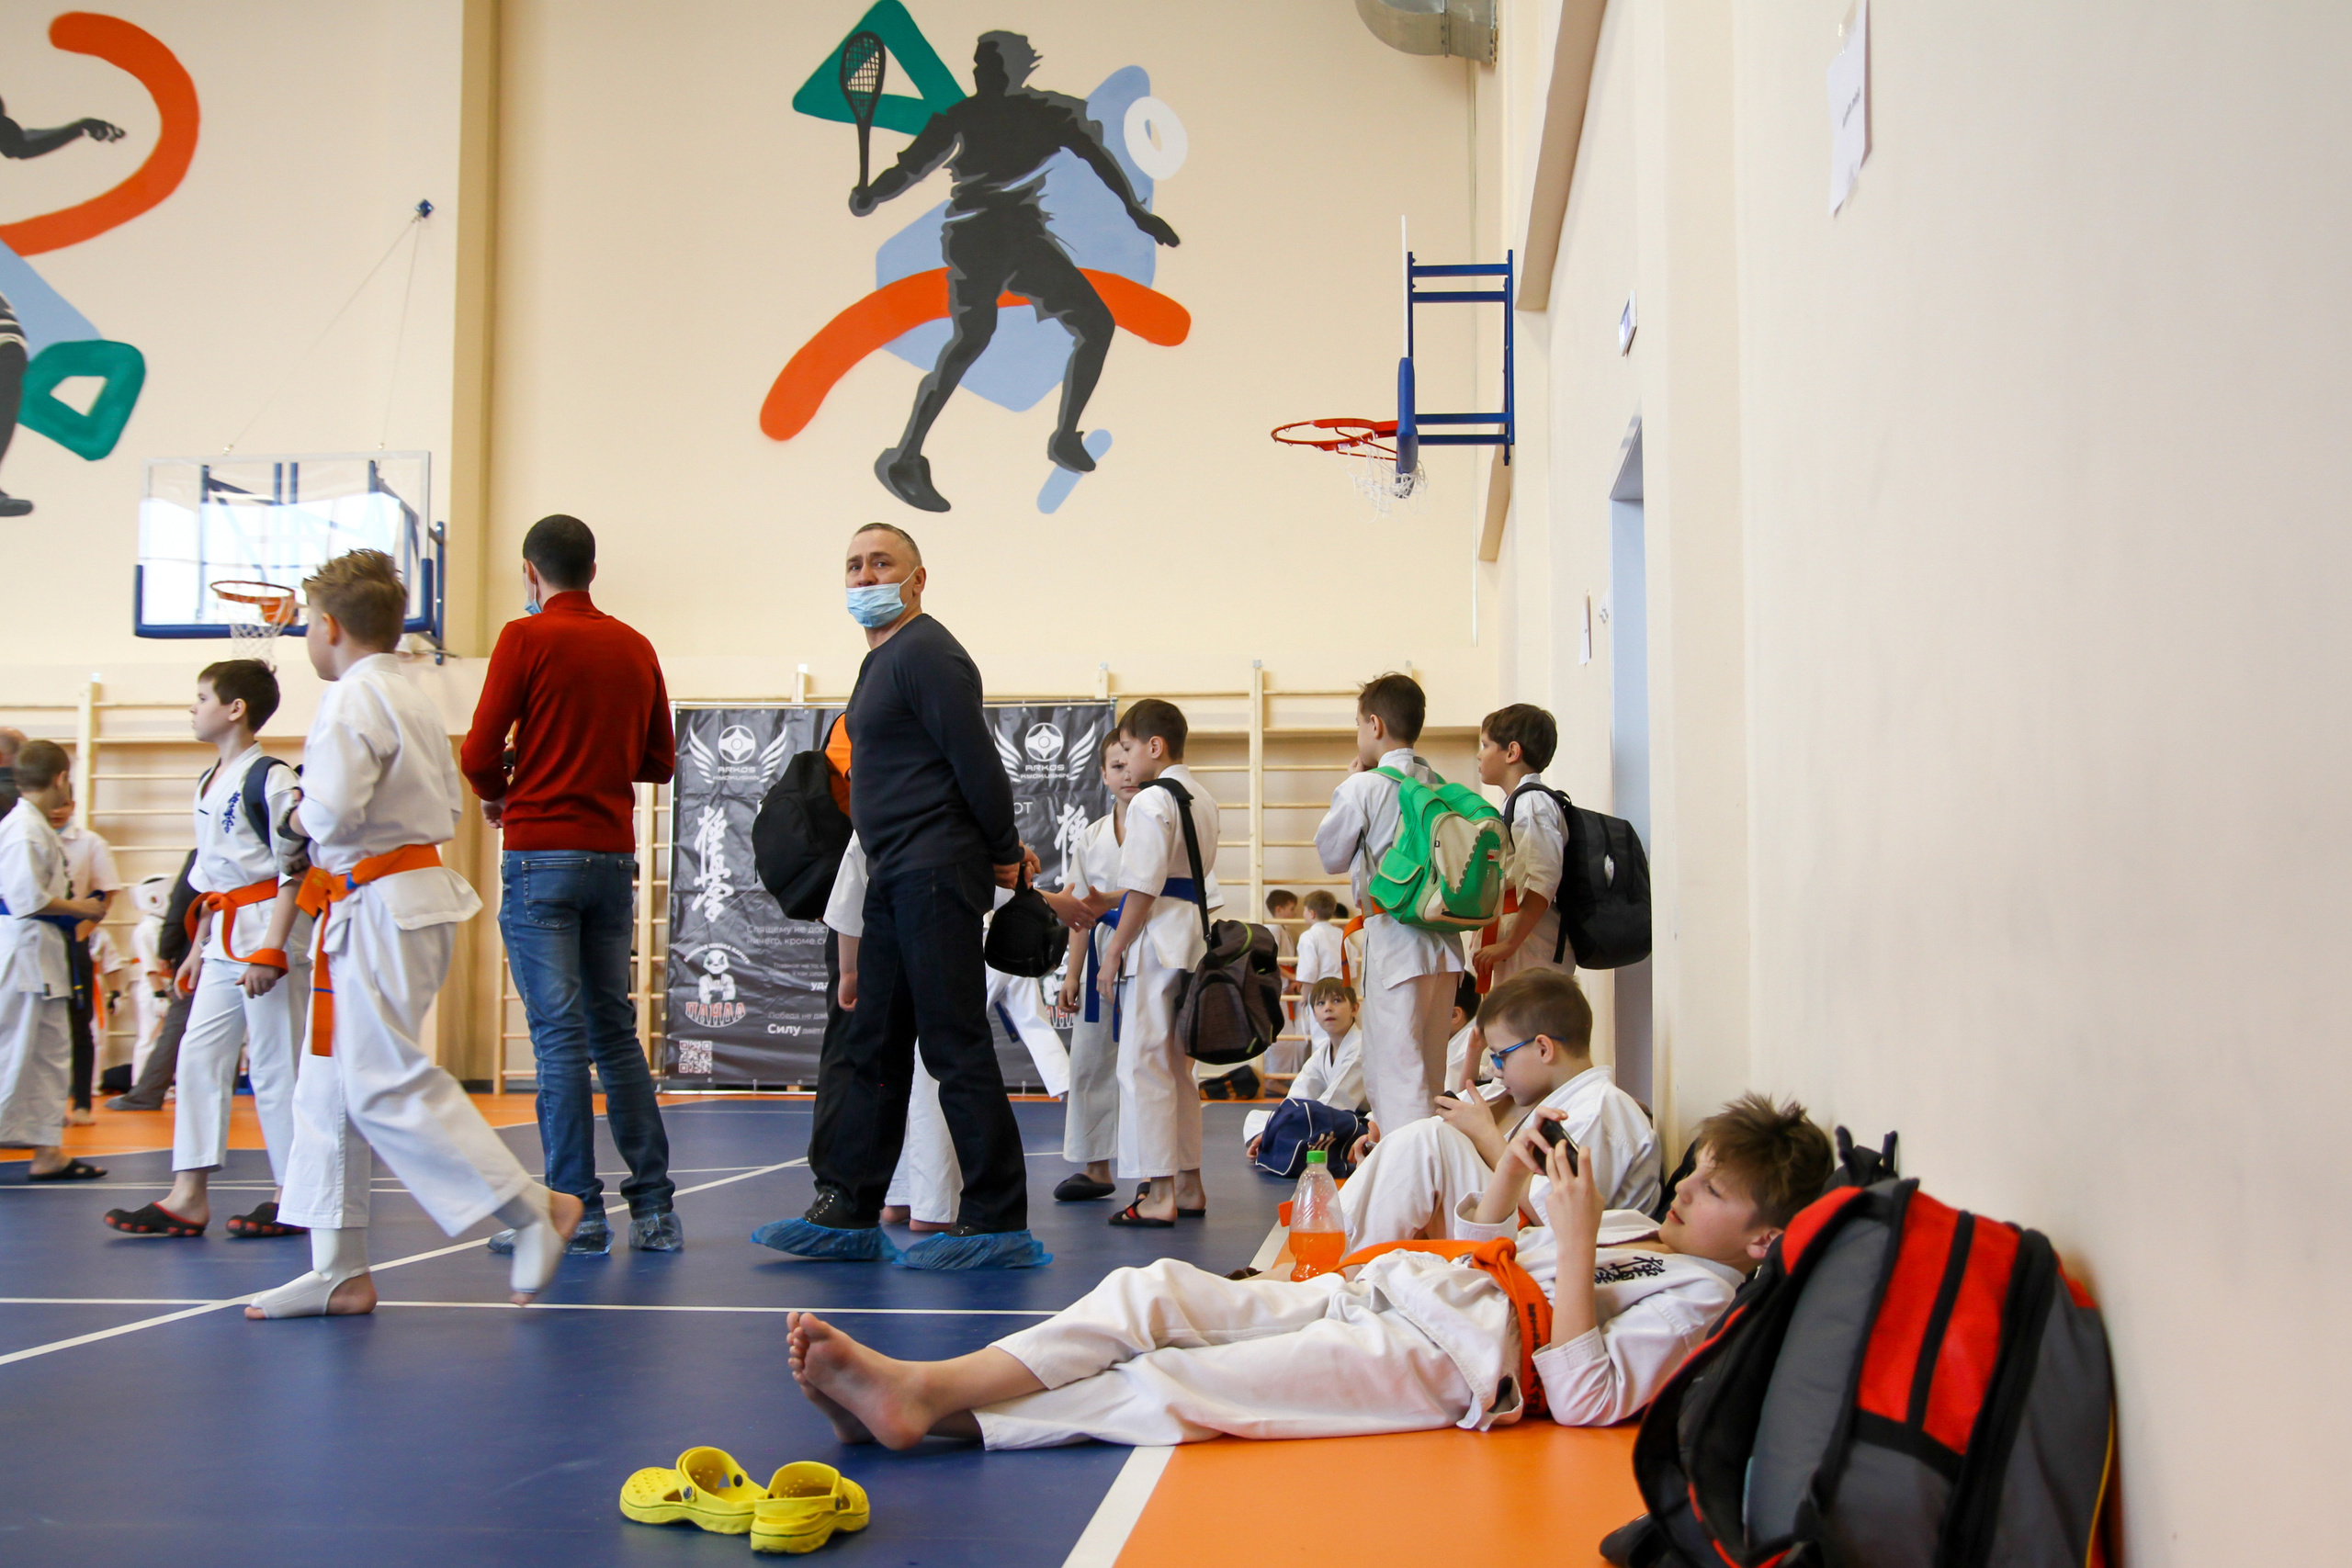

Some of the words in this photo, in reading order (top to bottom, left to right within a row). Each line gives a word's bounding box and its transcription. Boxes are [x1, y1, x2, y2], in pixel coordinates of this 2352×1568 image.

[746, 924, 791, 935] Спящему
[684, 1001, 746, 1028] ПАНДА
[768, 1011, 800, 1020] Победа
[767, 1023, 801, 1037] Силу
